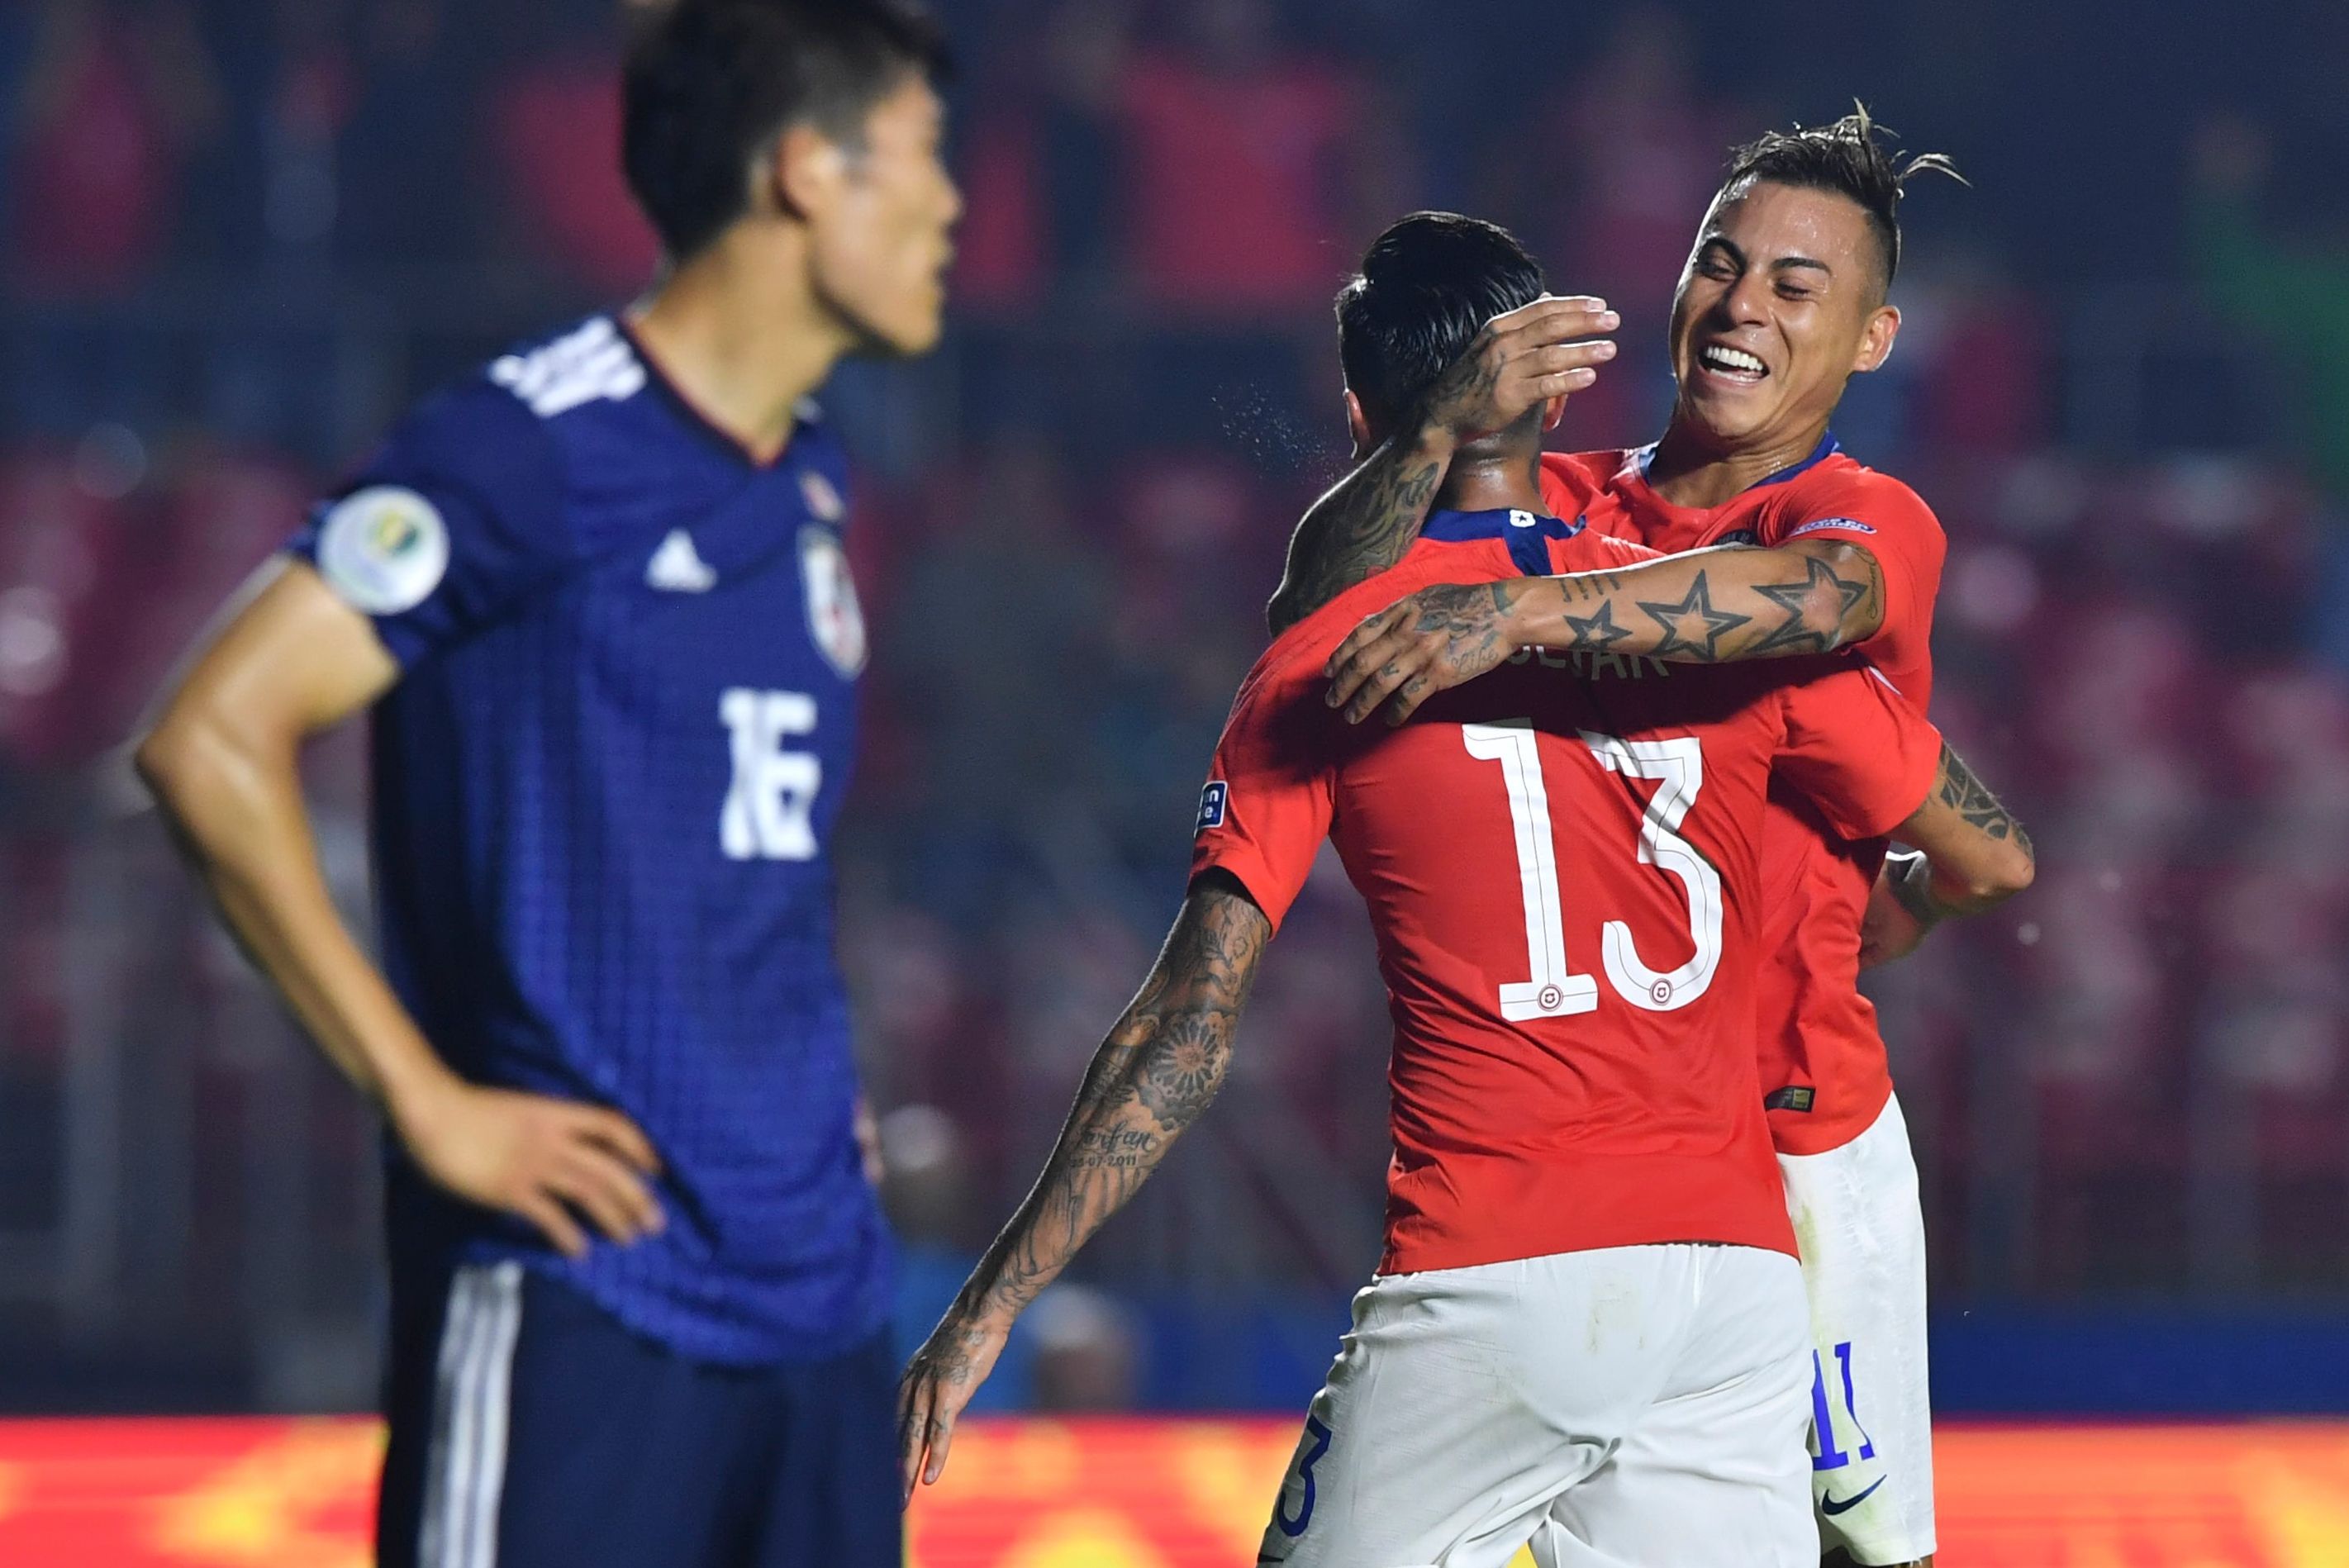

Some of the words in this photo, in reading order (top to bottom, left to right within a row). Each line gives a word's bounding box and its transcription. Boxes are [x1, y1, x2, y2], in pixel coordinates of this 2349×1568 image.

[718, 687, 822, 860] 16
[1462, 716, 1724, 1023] 13
[1811, 1341, 1876, 1471] 11
